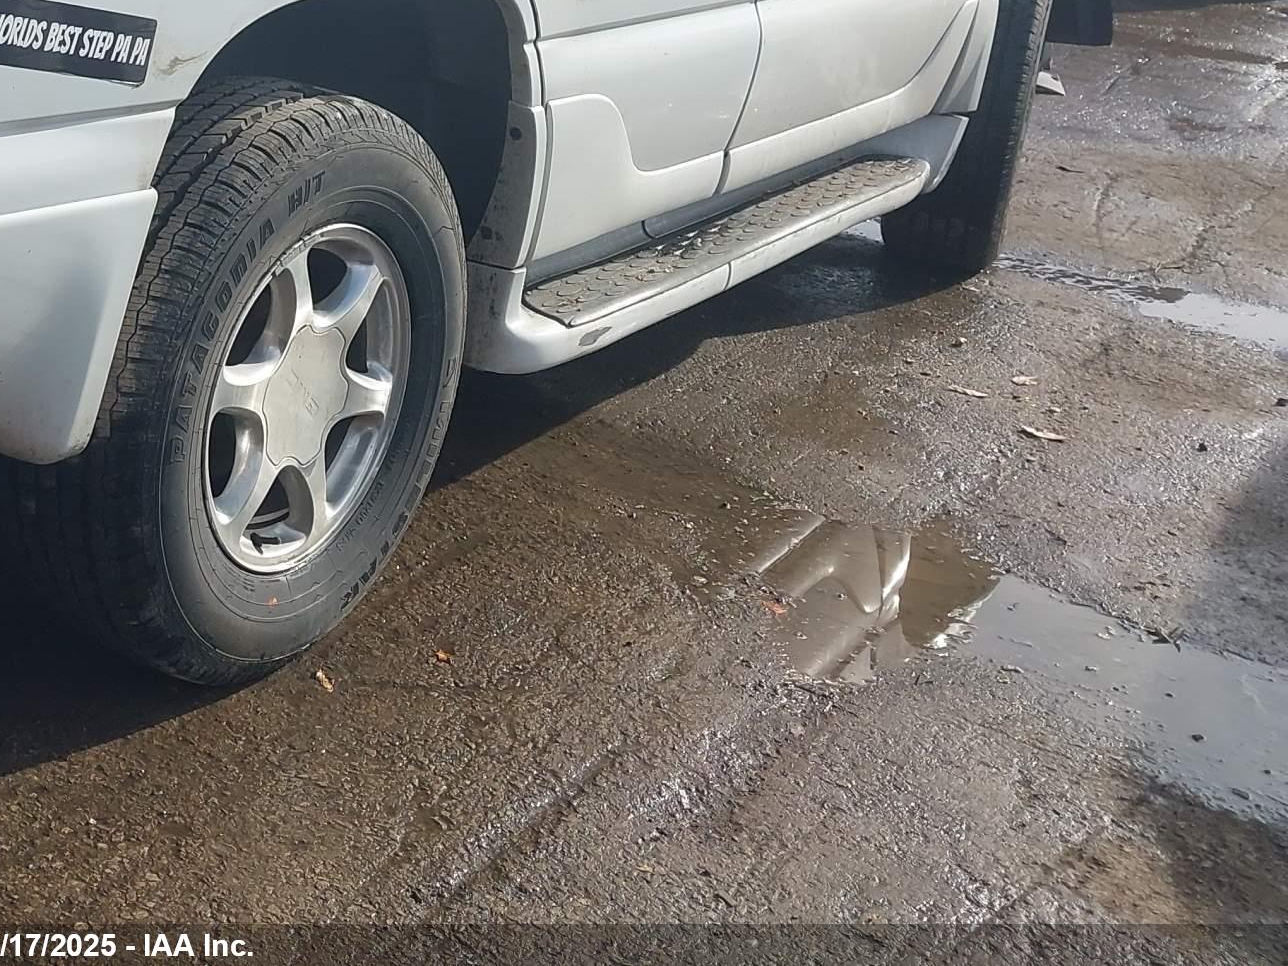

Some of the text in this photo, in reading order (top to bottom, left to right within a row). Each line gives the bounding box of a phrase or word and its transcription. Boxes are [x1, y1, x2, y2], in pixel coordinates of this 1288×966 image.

[43, 21, 83, 55] BEST
[78, 28, 115, 61] STEP
[169, 217, 276, 466] PATAGONIA
